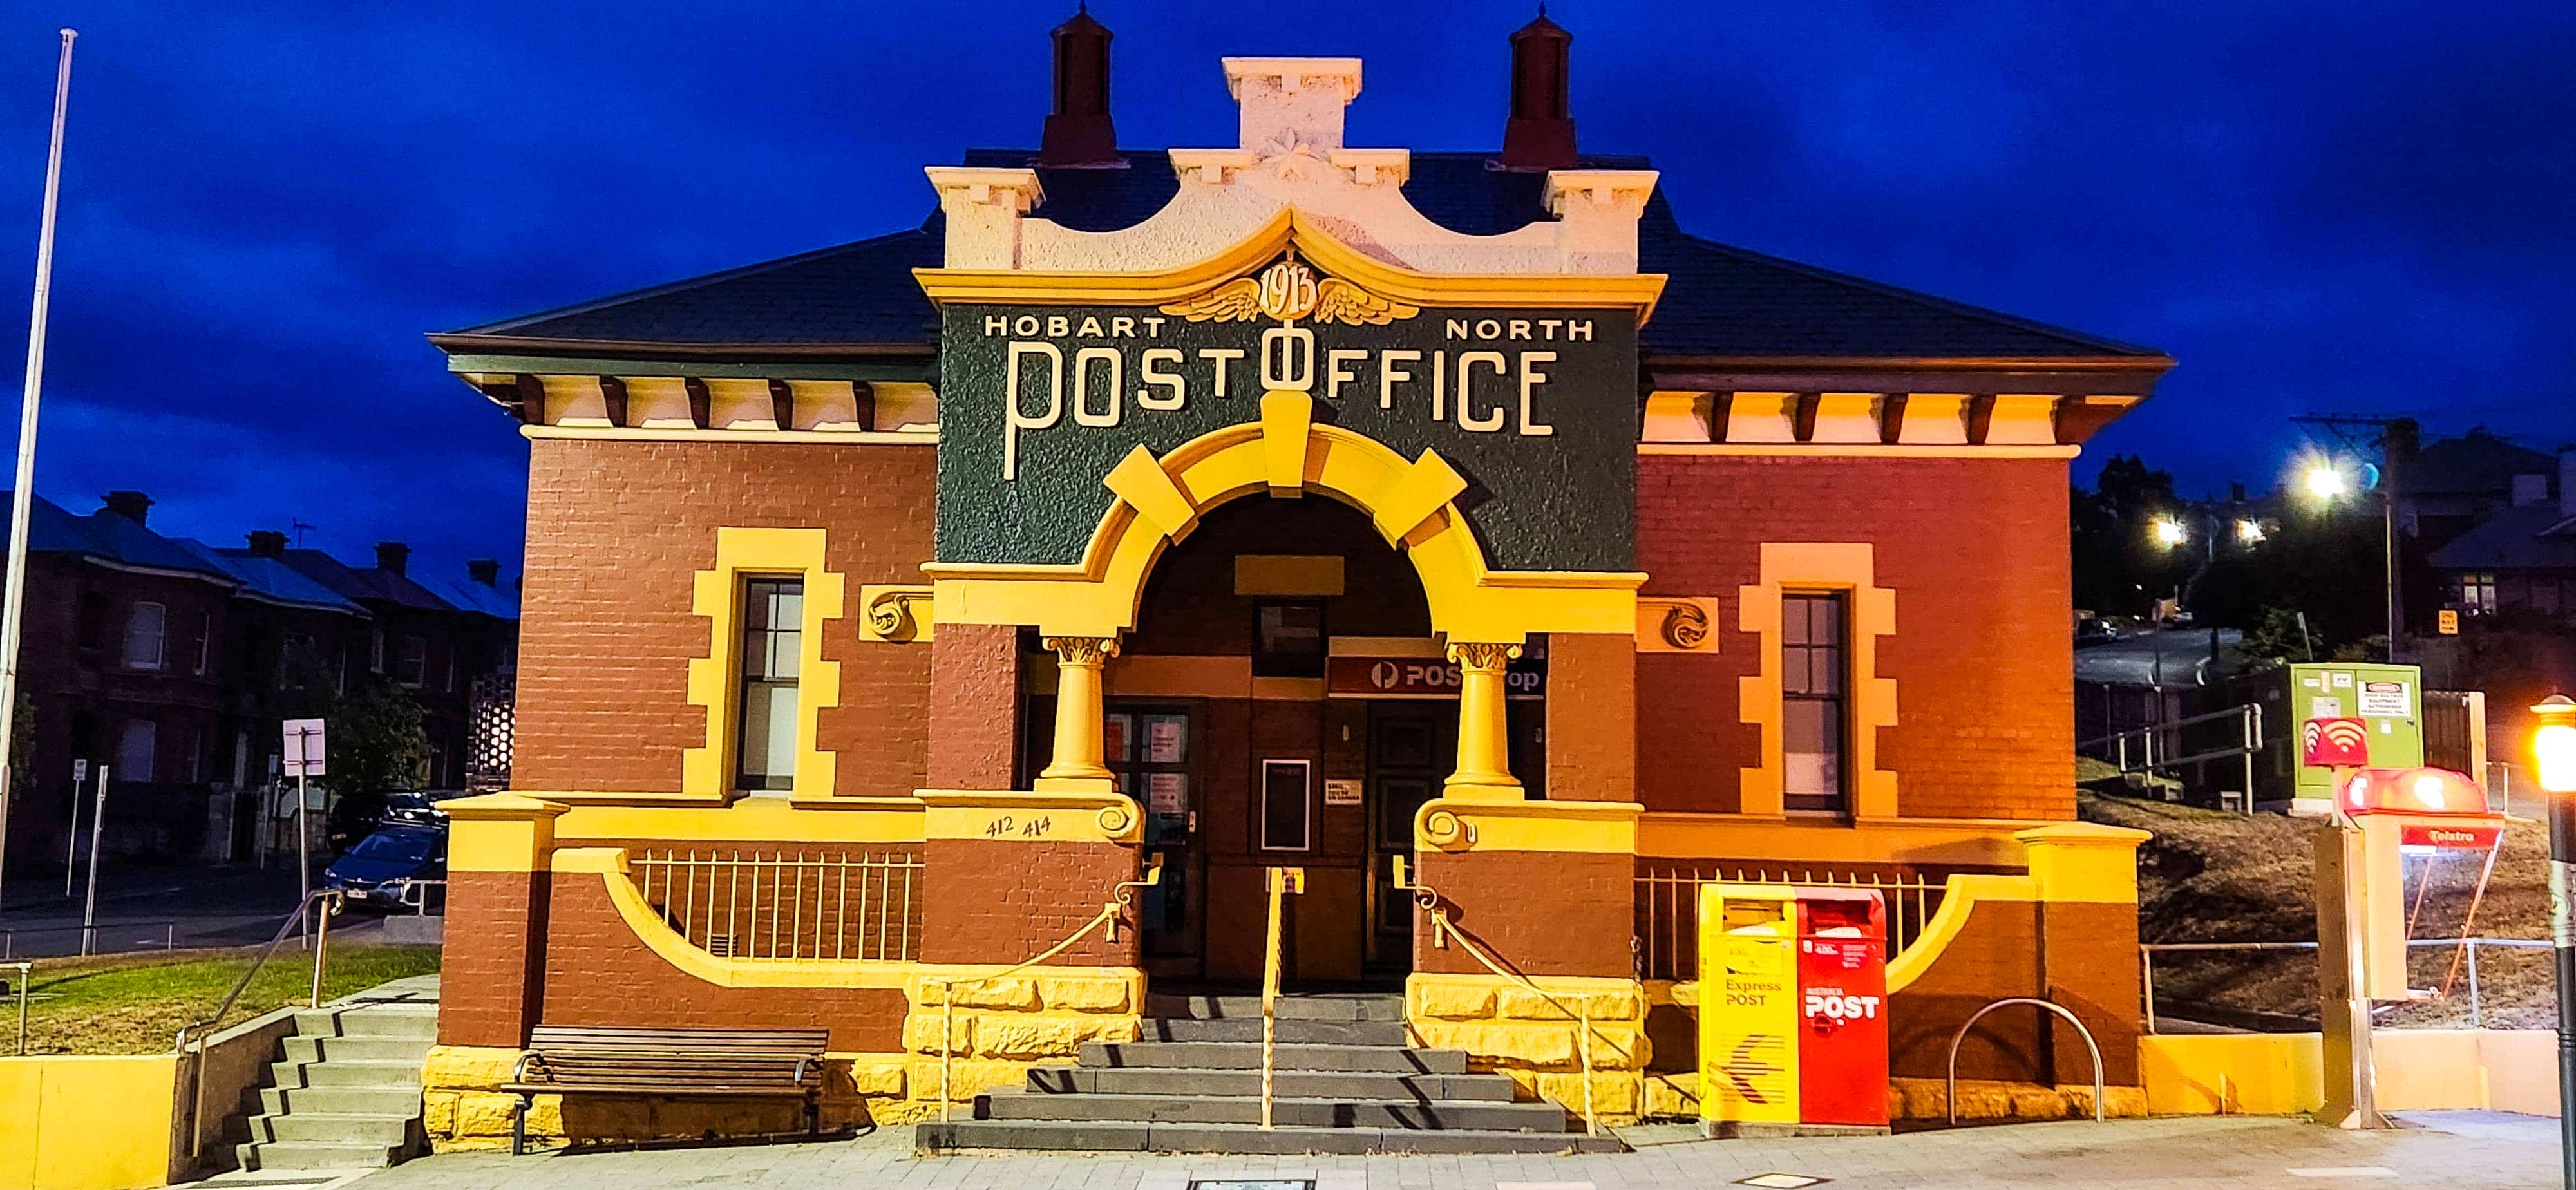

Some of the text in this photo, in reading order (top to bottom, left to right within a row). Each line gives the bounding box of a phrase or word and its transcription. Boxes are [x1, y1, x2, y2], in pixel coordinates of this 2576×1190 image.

[1260, 264, 1317, 314] 1913
[985, 315, 1593, 341] HOBART NORTH
[1003, 319, 1557, 480] POST OFFICE
[1406, 665, 1463, 686] POS
[985, 815, 1051, 838] 412 414
[2429, 830, 2474, 842] Telstra
[1727, 979, 1781, 993] Express
[1727, 994, 1766, 1006] POST
[1806, 996, 1880, 1019] POST
